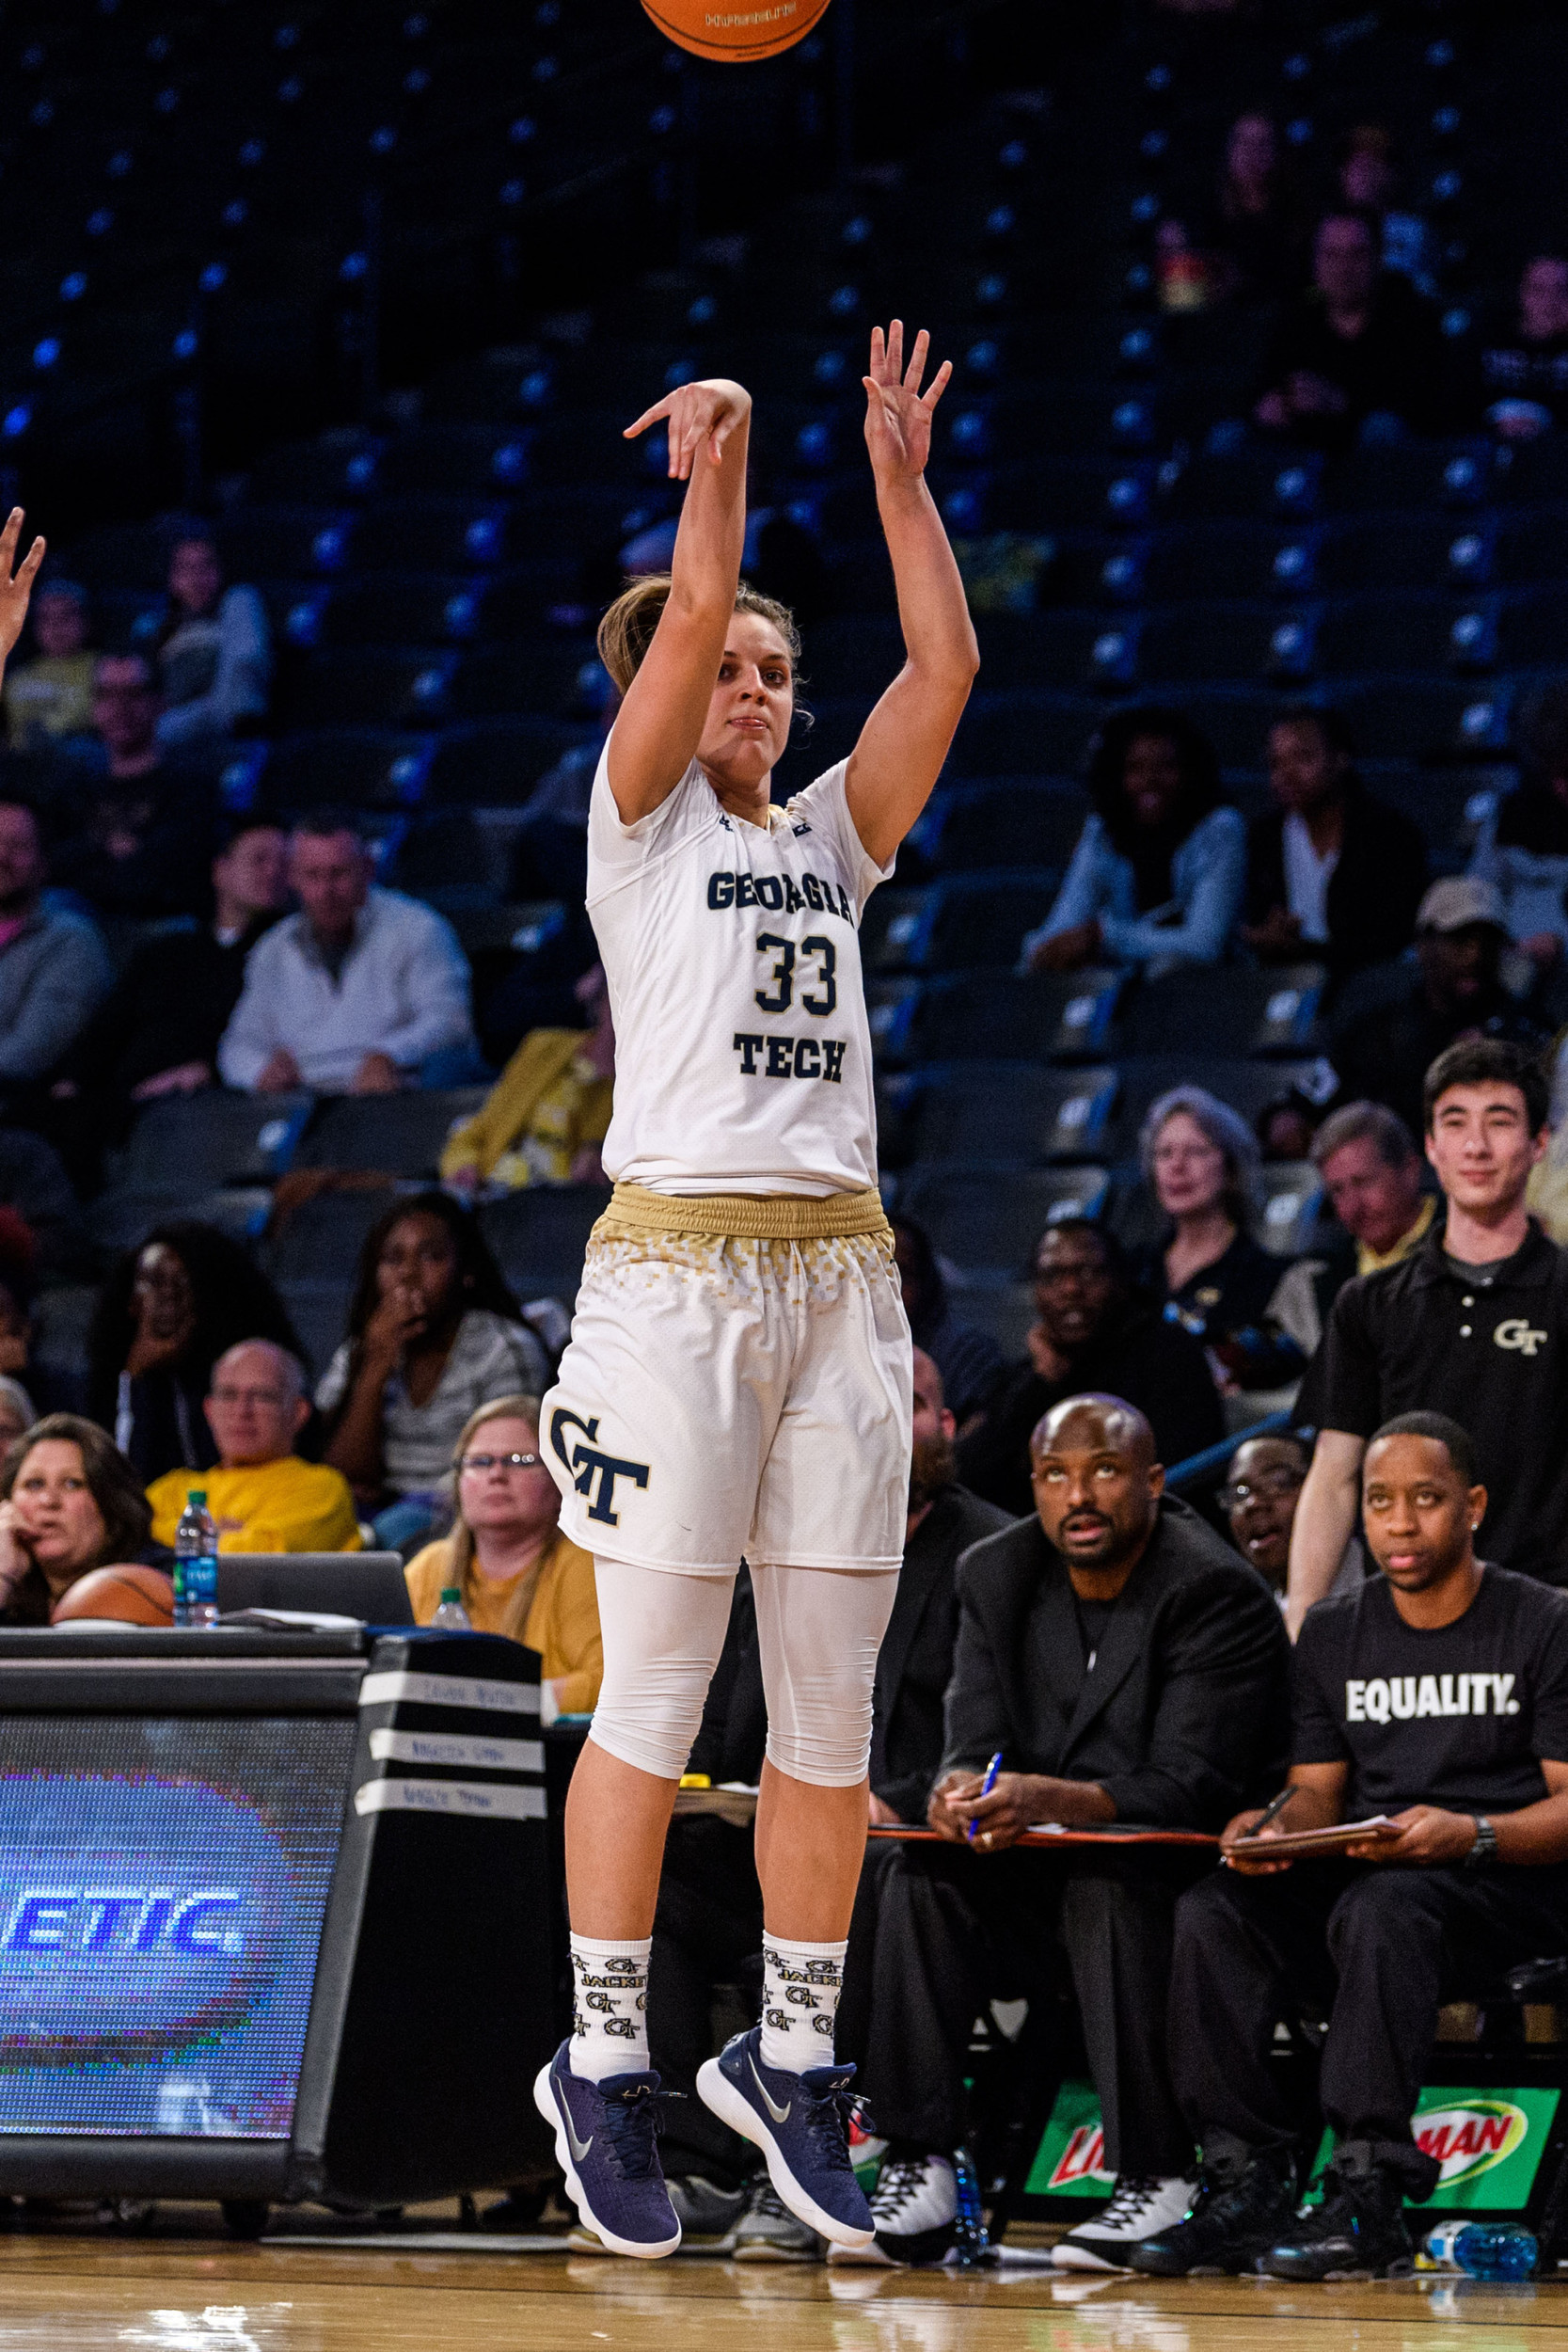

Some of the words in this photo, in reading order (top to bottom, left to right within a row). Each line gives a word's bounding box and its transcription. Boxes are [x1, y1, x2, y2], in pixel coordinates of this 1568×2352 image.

[707, 871, 855, 930] GEORGIA
[754, 931, 838, 1019] 33
[733, 1033, 847, 1083] TECH
[1494, 1319, 1547, 1356] GT
[548, 1406, 652, 1529] GT
[1346, 1673, 1520, 1724] EQUALITY.
